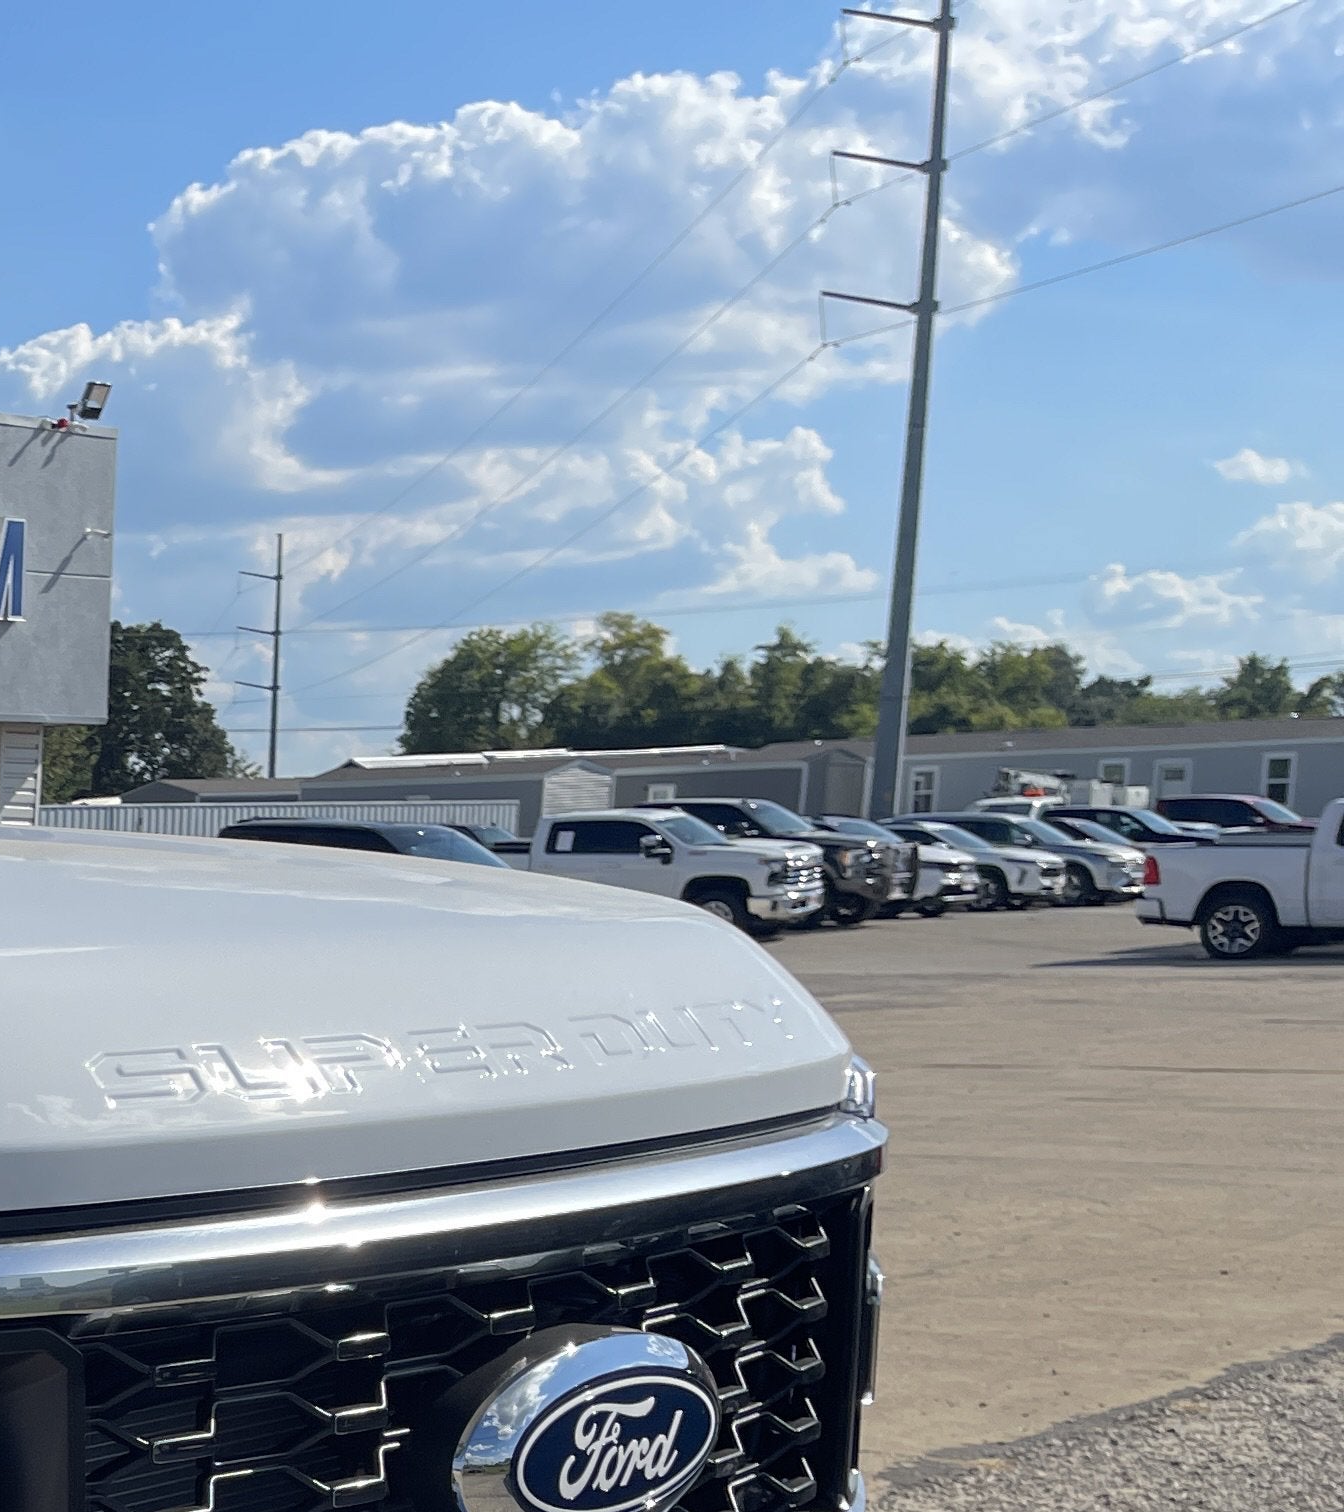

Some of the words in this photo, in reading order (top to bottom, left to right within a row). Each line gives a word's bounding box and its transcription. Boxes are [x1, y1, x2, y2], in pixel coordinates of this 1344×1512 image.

[82, 1020, 574, 1109] SUPER
[567, 997, 794, 1067] DUTY
[558, 1396, 683, 1500] Ford
